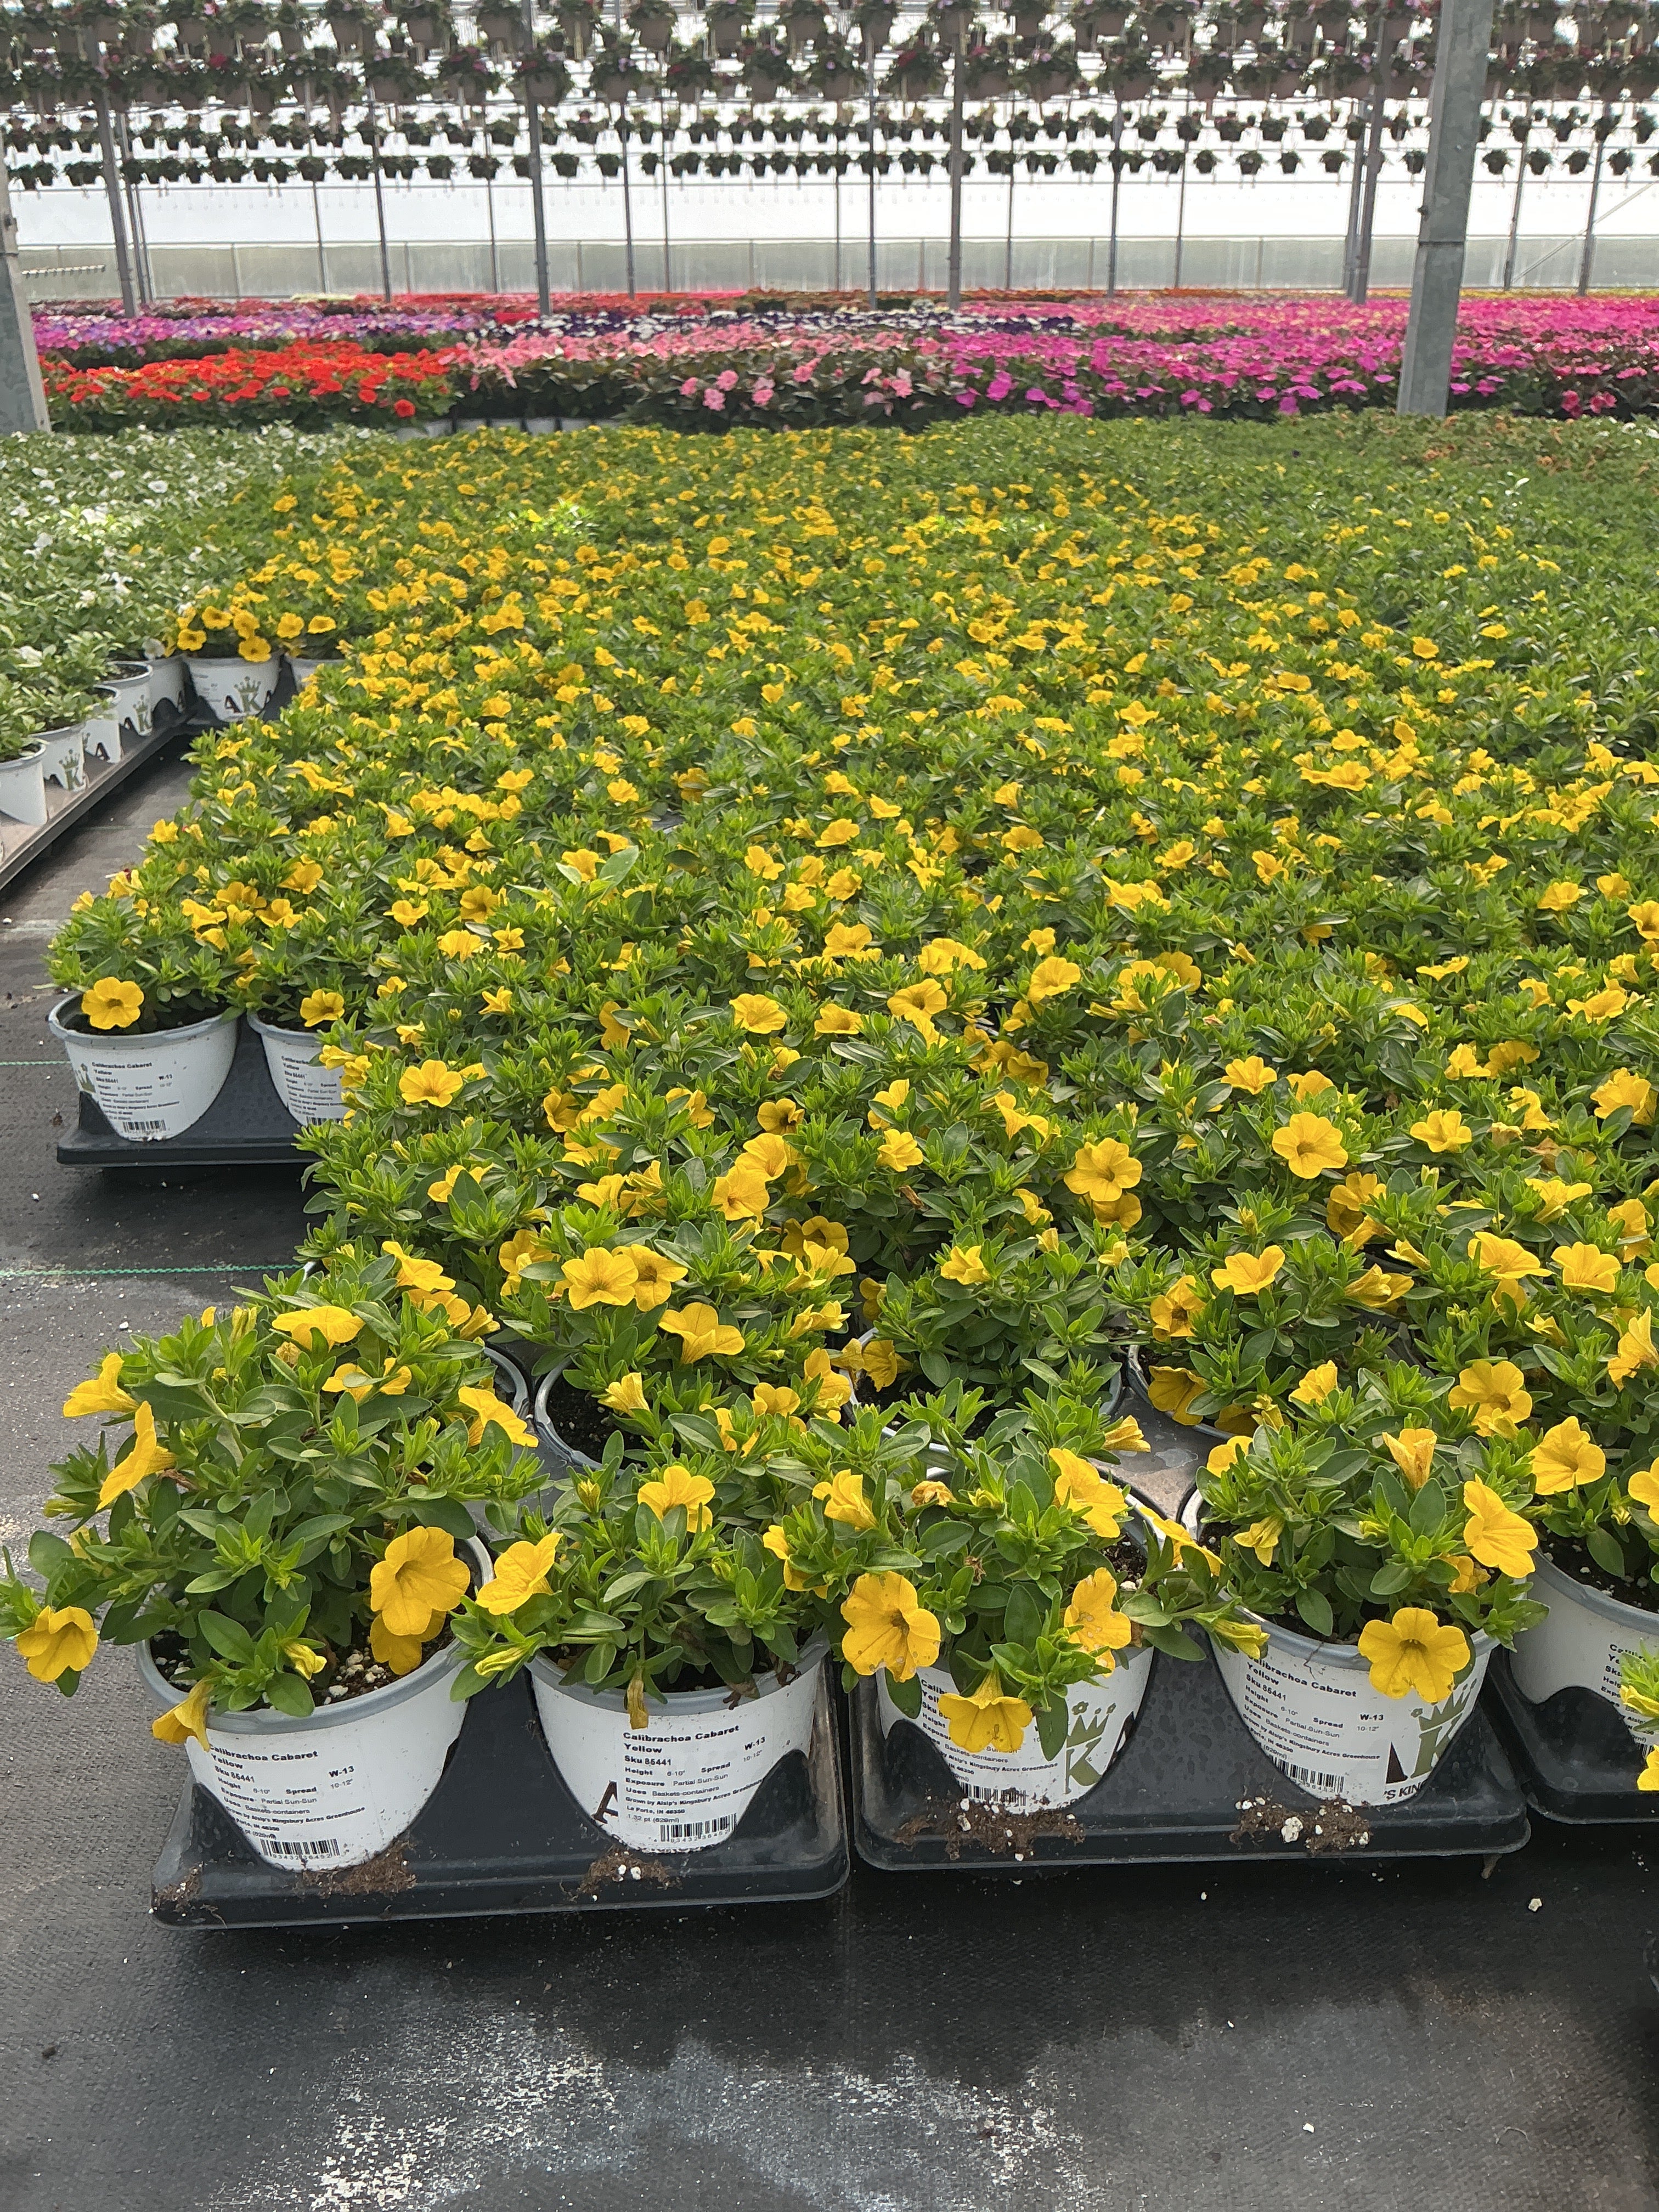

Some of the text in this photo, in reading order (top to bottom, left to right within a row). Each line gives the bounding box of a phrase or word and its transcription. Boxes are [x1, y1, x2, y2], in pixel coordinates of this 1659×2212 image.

[1246, 1674, 1261, 1688] Sku
[1247, 1662, 1279, 1685] Yellow
[1250, 1656, 1357, 1697] alibrachoa Cabaret
[922, 1689, 939, 1703] Yell
[922, 1701, 936, 1714] Sku
[1245, 1685, 1269, 1703] Height
[1313, 1717, 1344, 1729] Spread
[922, 1712, 946, 1728] Height
[1245, 1695, 1340, 1738] Exposure Partial Sun-Sun
[923, 1723, 951, 1740] Exposur
[1244, 1704, 1329, 1746] Uses Baskets-containers
[623, 1725, 739, 1742] Calibrachoa Cabaret
[624, 1743, 662, 1753] Yellow
[744, 1736, 765, 1751] W-13
[1289, 1739, 1321, 1754] Kingsbury
[272, 1751, 318, 1761] Cabaret
[624, 1755, 642, 1764] Sku
[945, 1743, 1008, 1763] Baskets-containers
[211, 1753, 243, 1769] Yellow
[949, 1754, 967, 1764] Alsip's
[969, 1761, 1001, 1773] Kingsbury
[1022, 1763, 1058, 1771] Greenhouse
[214, 1765, 229, 1776] Sku
[329, 1765, 355, 1778] W-13
[625, 1767, 653, 1776] Height
[701, 1762, 731, 1773] Spread
[218, 1777, 241, 1789] Height
[286, 1787, 317, 1795] Spread
[330, 1779, 353, 1789] 10-12"
[625, 1777, 665, 1786] Exposure
[697, 1774, 729, 1784] Sun-Sun
[626, 1786, 720, 1796] Uses Baskets-containers
[326, 1807, 365, 1820] Greenhouse
